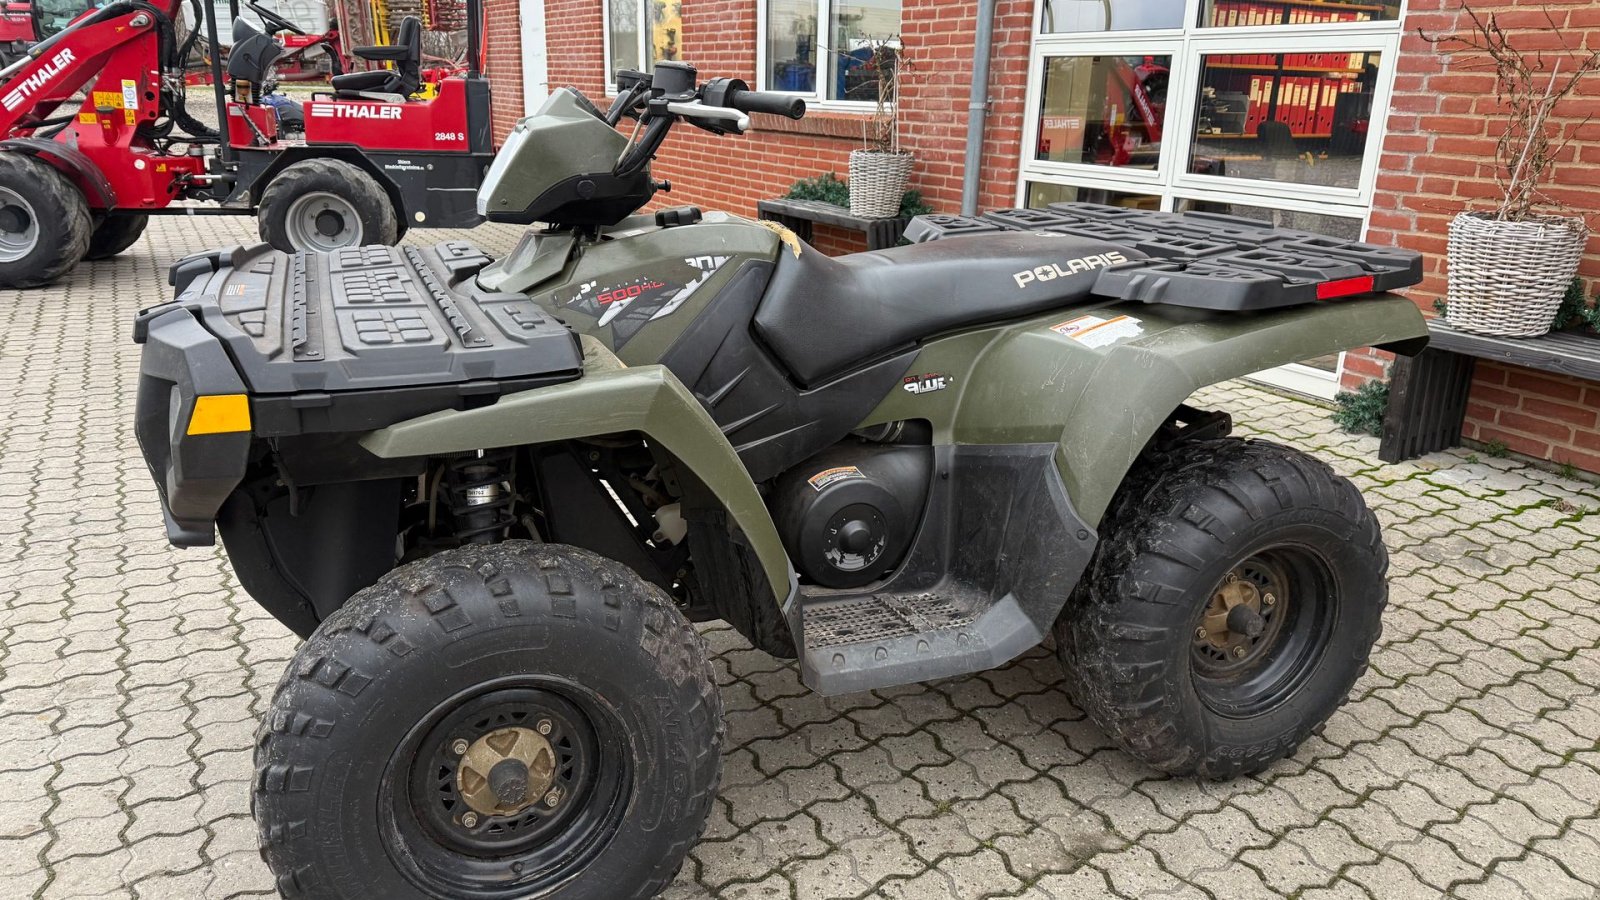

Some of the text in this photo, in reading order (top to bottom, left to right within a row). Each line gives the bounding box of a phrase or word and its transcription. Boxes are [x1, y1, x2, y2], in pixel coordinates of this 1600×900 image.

[17, 47, 76, 97] THALER
[334, 104, 403, 120] THALER
[434, 132, 465, 141] 2848 S
[1013, 250, 1128, 289] POLARIS
[596, 285, 641, 305] 500
